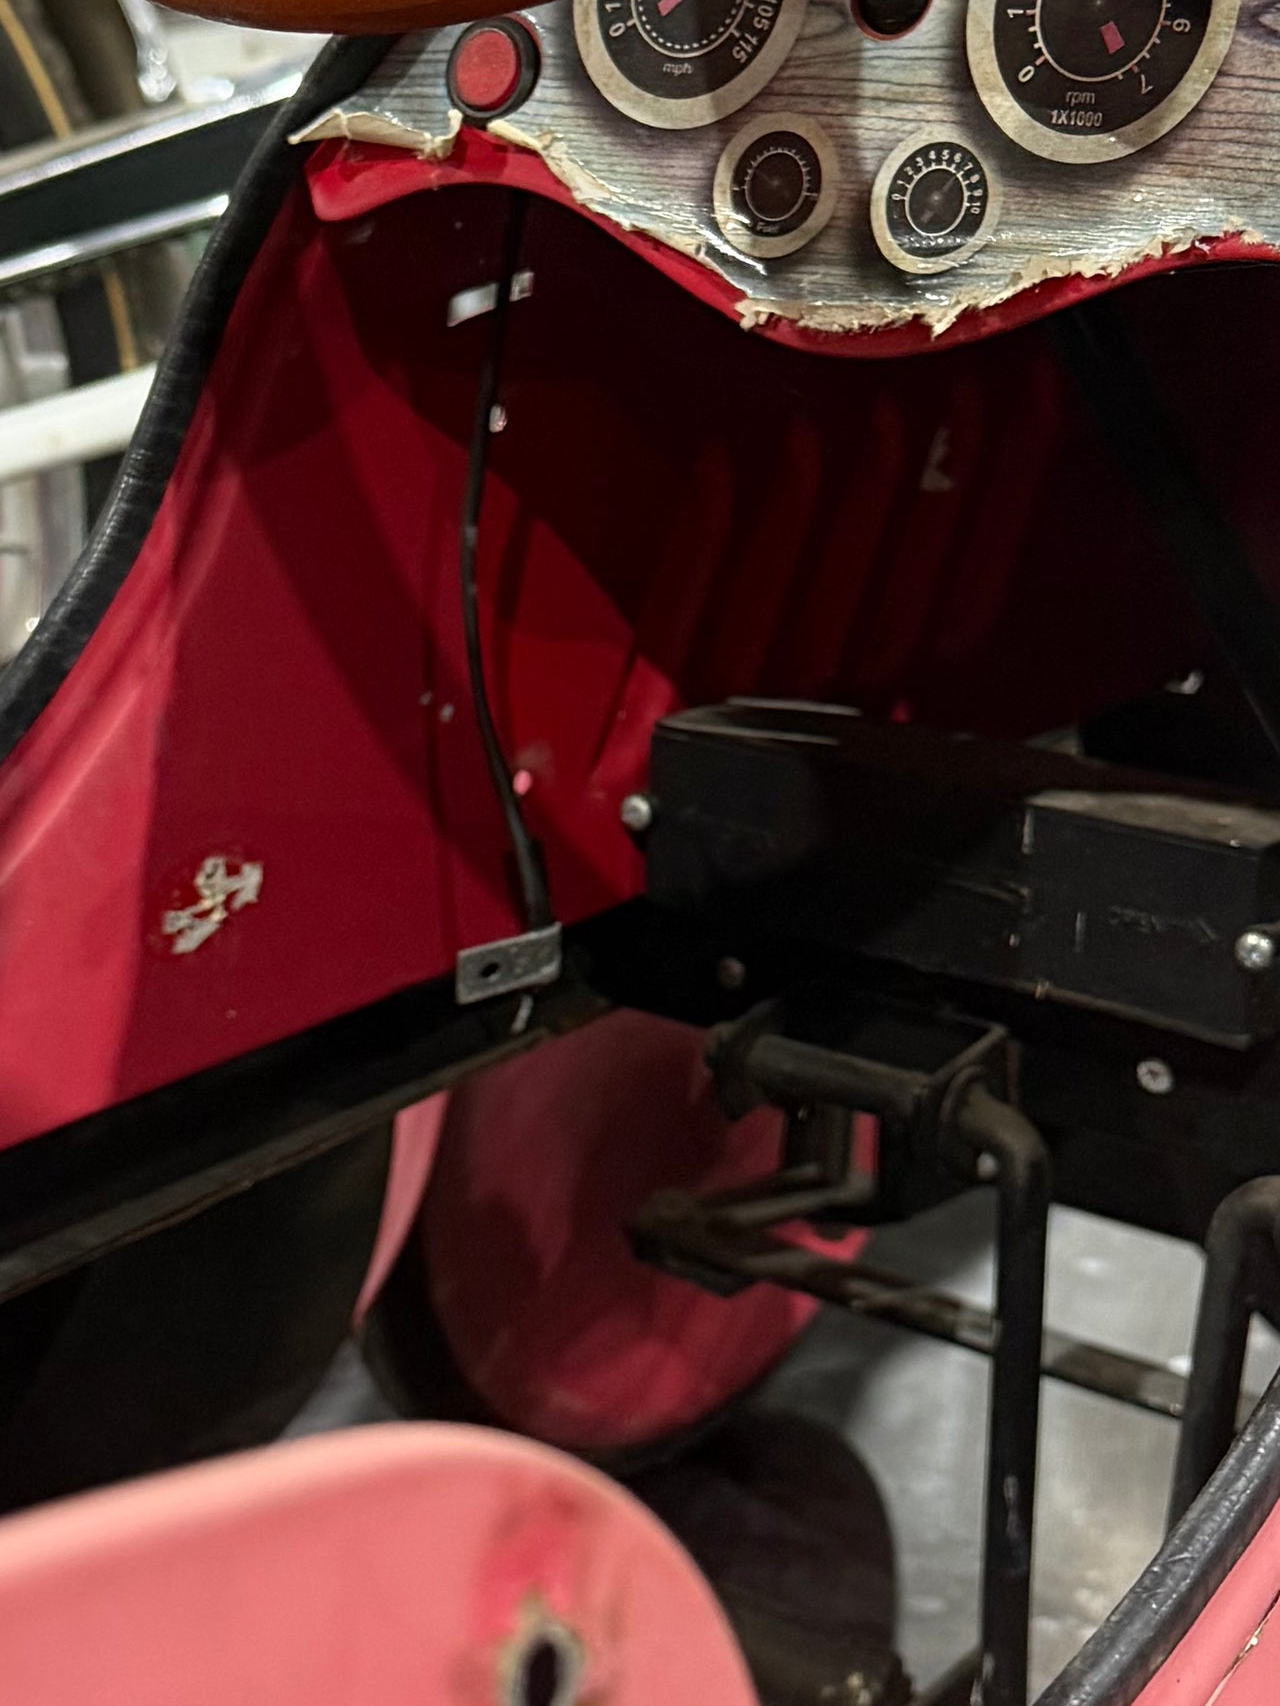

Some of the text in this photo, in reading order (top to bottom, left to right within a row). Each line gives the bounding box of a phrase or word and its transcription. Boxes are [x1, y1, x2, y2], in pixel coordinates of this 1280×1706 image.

[1006, 8, 1025, 20] 1
[1171, 17, 1192, 34] 6
[608, 22, 627, 37] 0
[732, 31, 761, 64] 115
[662, 62, 694, 77] mph
[1017, 64, 1036, 83] 0
[1139, 73, 1154, 95] 7
[1064, 90, 1097, 107] rpm
[1049, 108, 1104, 128] 1X1000
[928, 149, 937, 160] 4
[941, 149, 951, 161] 5
